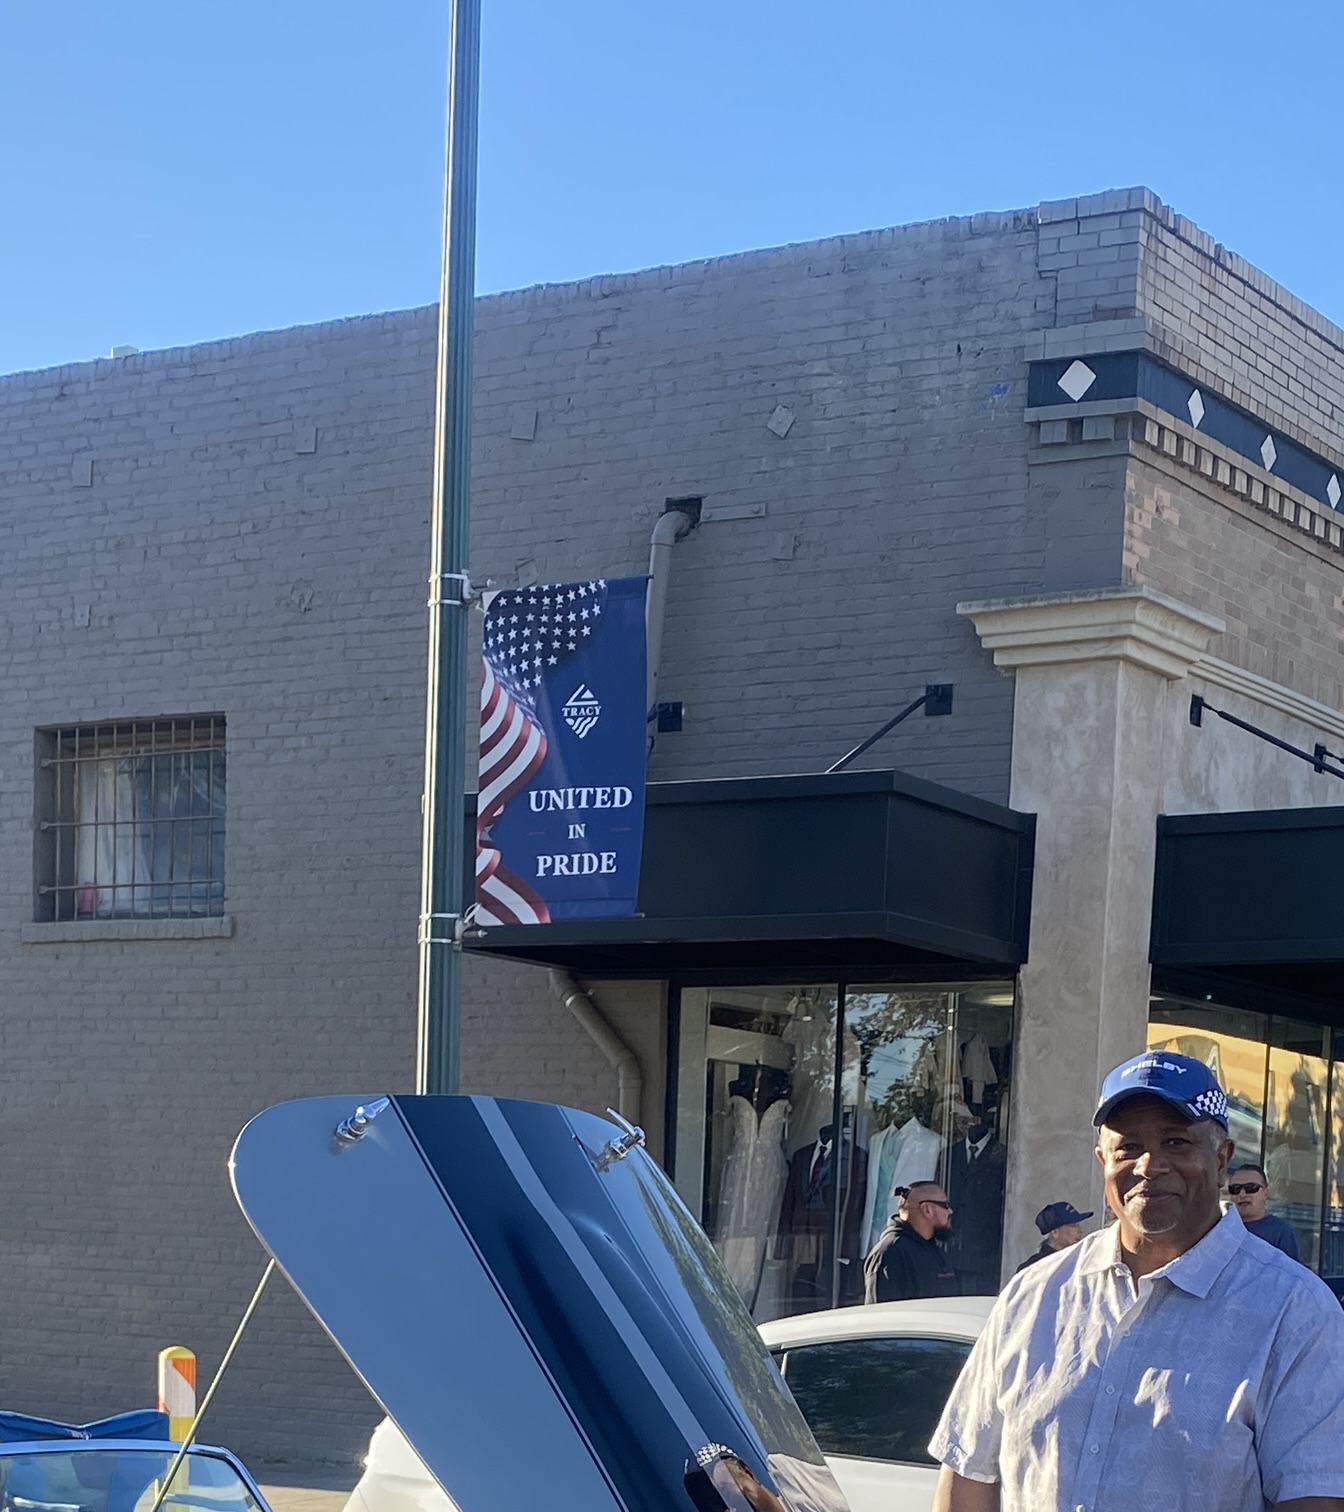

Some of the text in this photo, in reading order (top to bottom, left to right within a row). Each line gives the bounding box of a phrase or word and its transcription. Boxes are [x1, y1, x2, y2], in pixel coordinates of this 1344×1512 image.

[561, 705, 602, 717] TRACY
[528, 786, 633, 813] UNITED
[567, 822, 586, 839] IN
[535, 851, 618, 877] PRIDE
[1121, 1059, 1187, 1078] SHELBY
